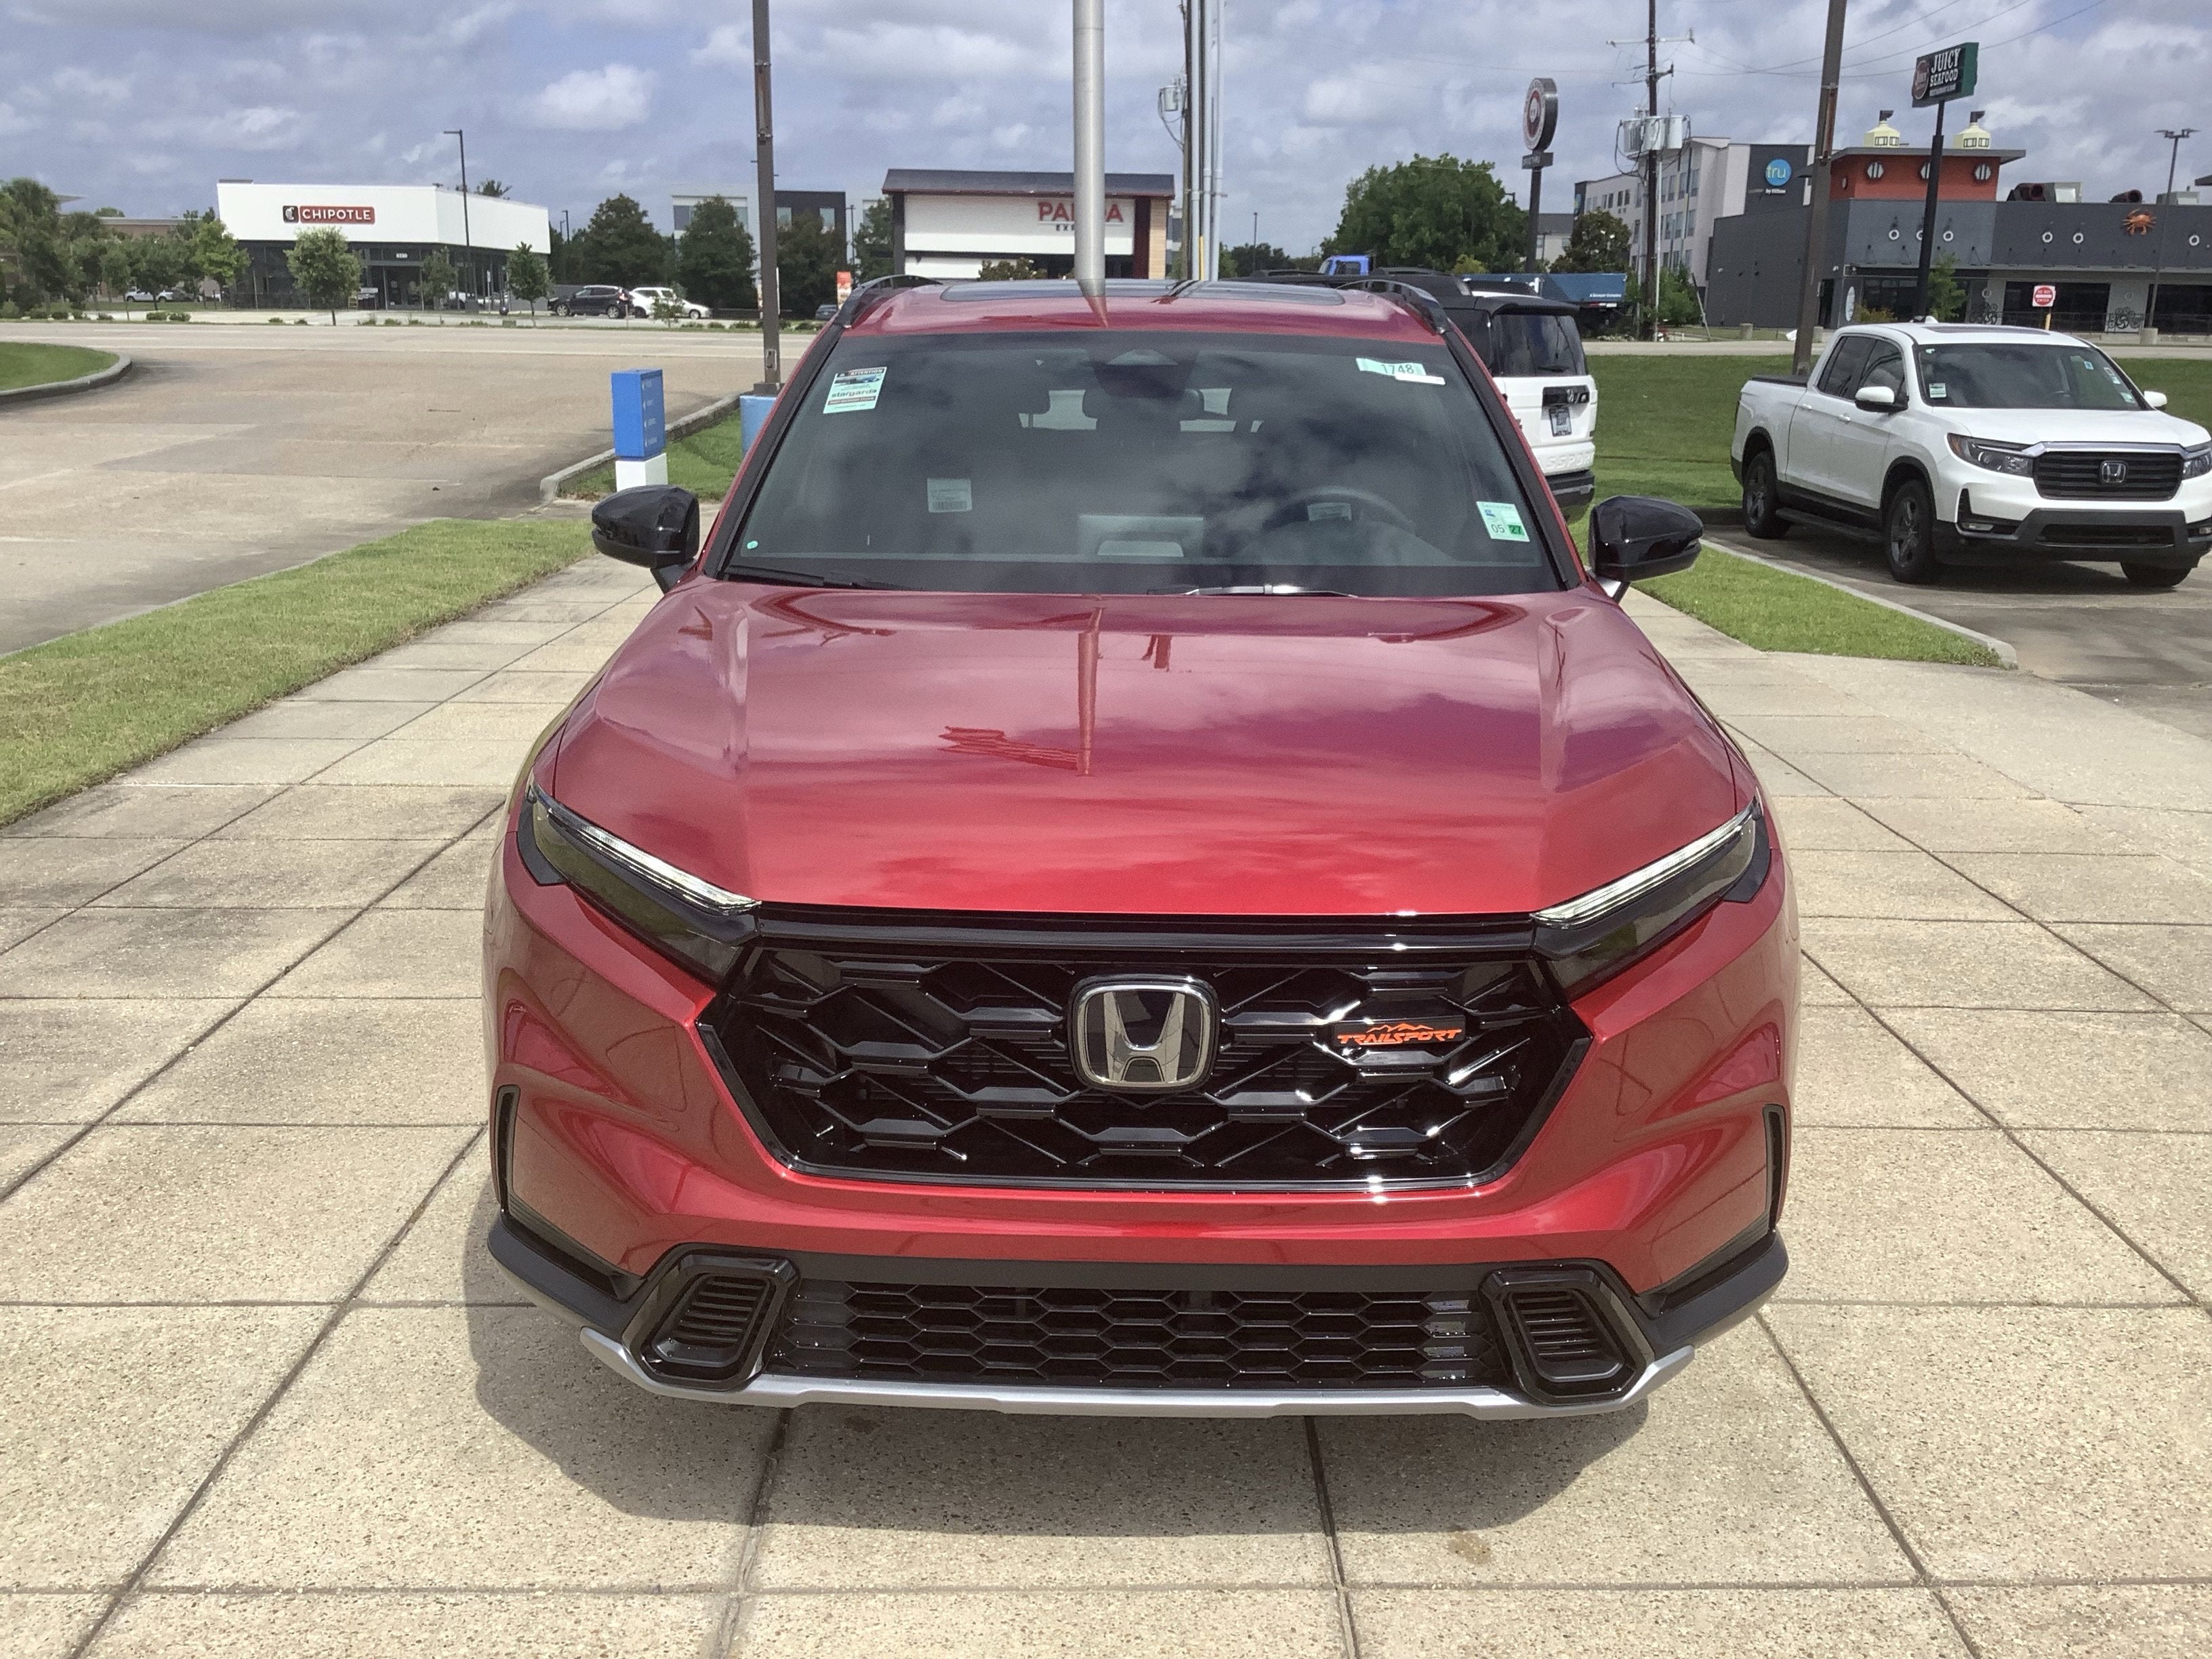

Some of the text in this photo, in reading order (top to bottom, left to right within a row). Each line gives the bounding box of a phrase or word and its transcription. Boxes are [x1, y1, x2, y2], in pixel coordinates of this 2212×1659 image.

[1931, 47, 1961, 74] JUICY
[1929, 68, 1959, 87] SEAFOOD
[1766, 165, 1786, 178] tru
[302, 209, 371, 220] CHIPOTLE
[1038, 201, 1124, 222] PAA
[1491, 524, 1505, 533] 05
[1337, 1029, 1462, 1046] TRAILSPORT
